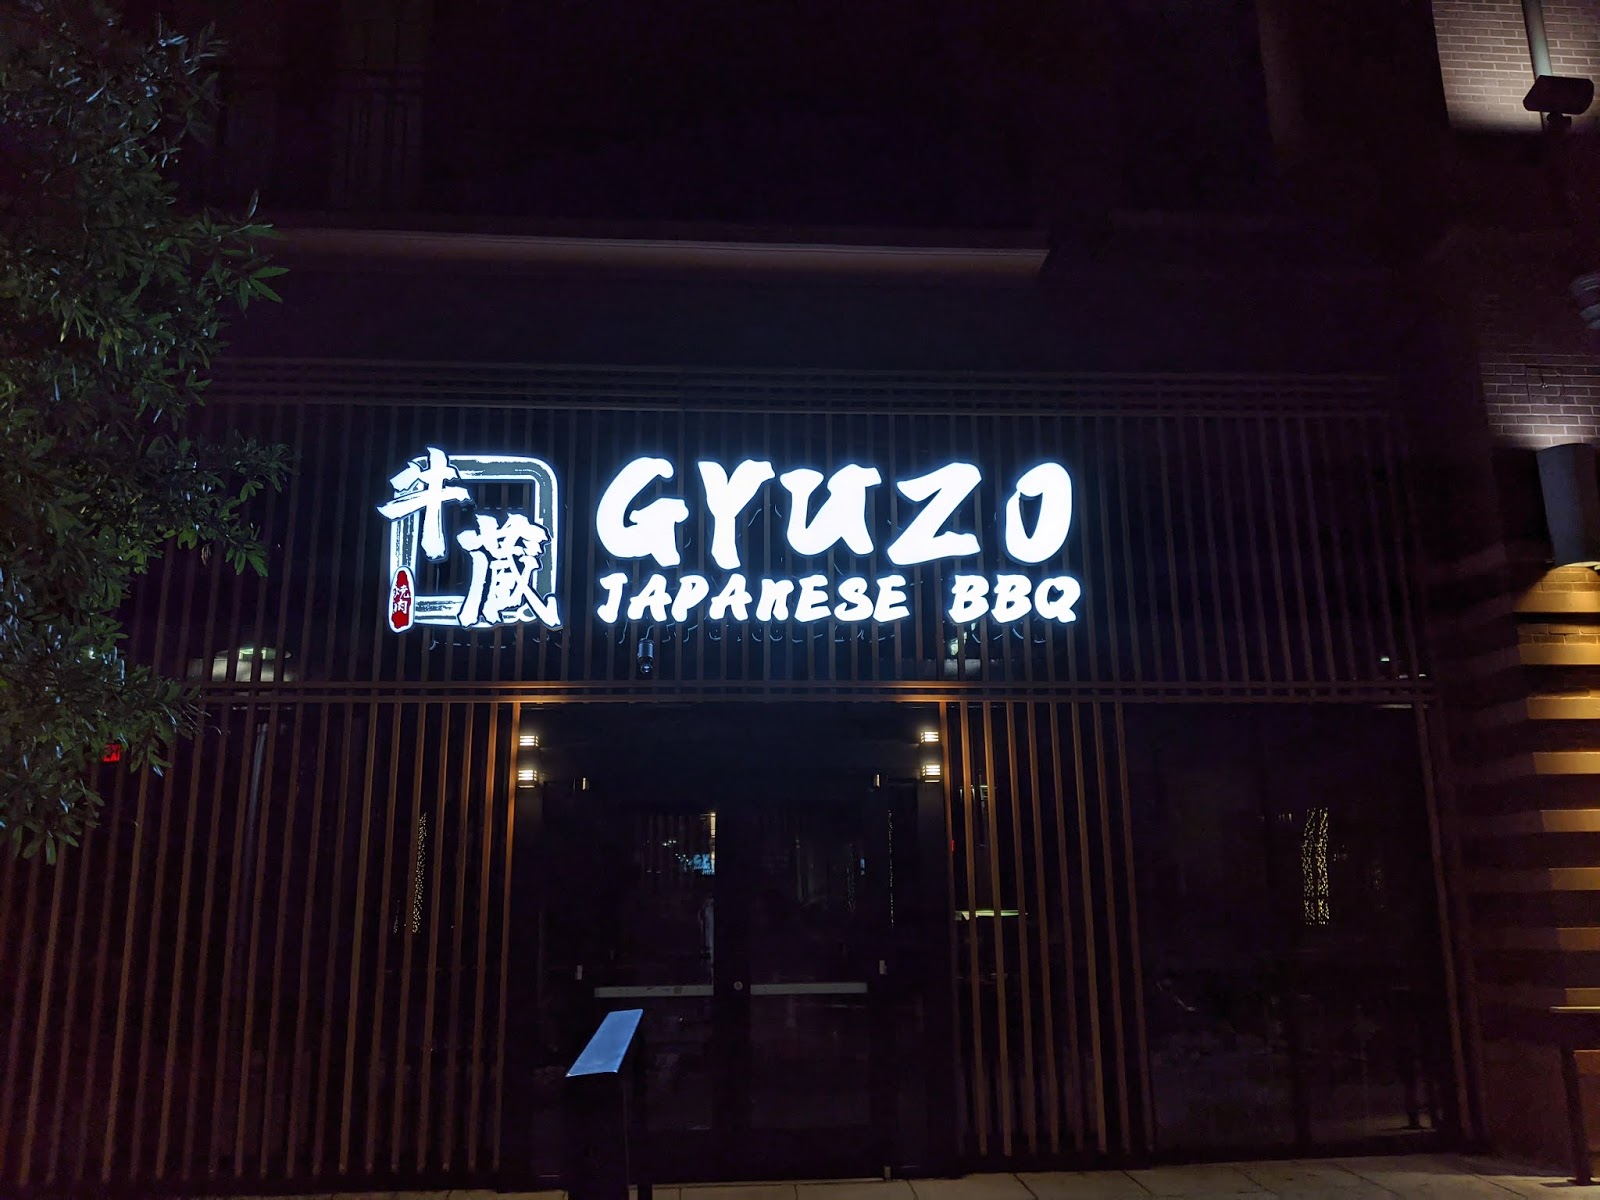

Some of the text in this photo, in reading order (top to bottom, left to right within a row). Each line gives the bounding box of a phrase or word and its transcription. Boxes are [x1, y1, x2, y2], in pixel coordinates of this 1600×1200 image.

[596, 456, 1073, 570] GYUZO
[597, 572, 1081, 624] JAPANESE BBQ
